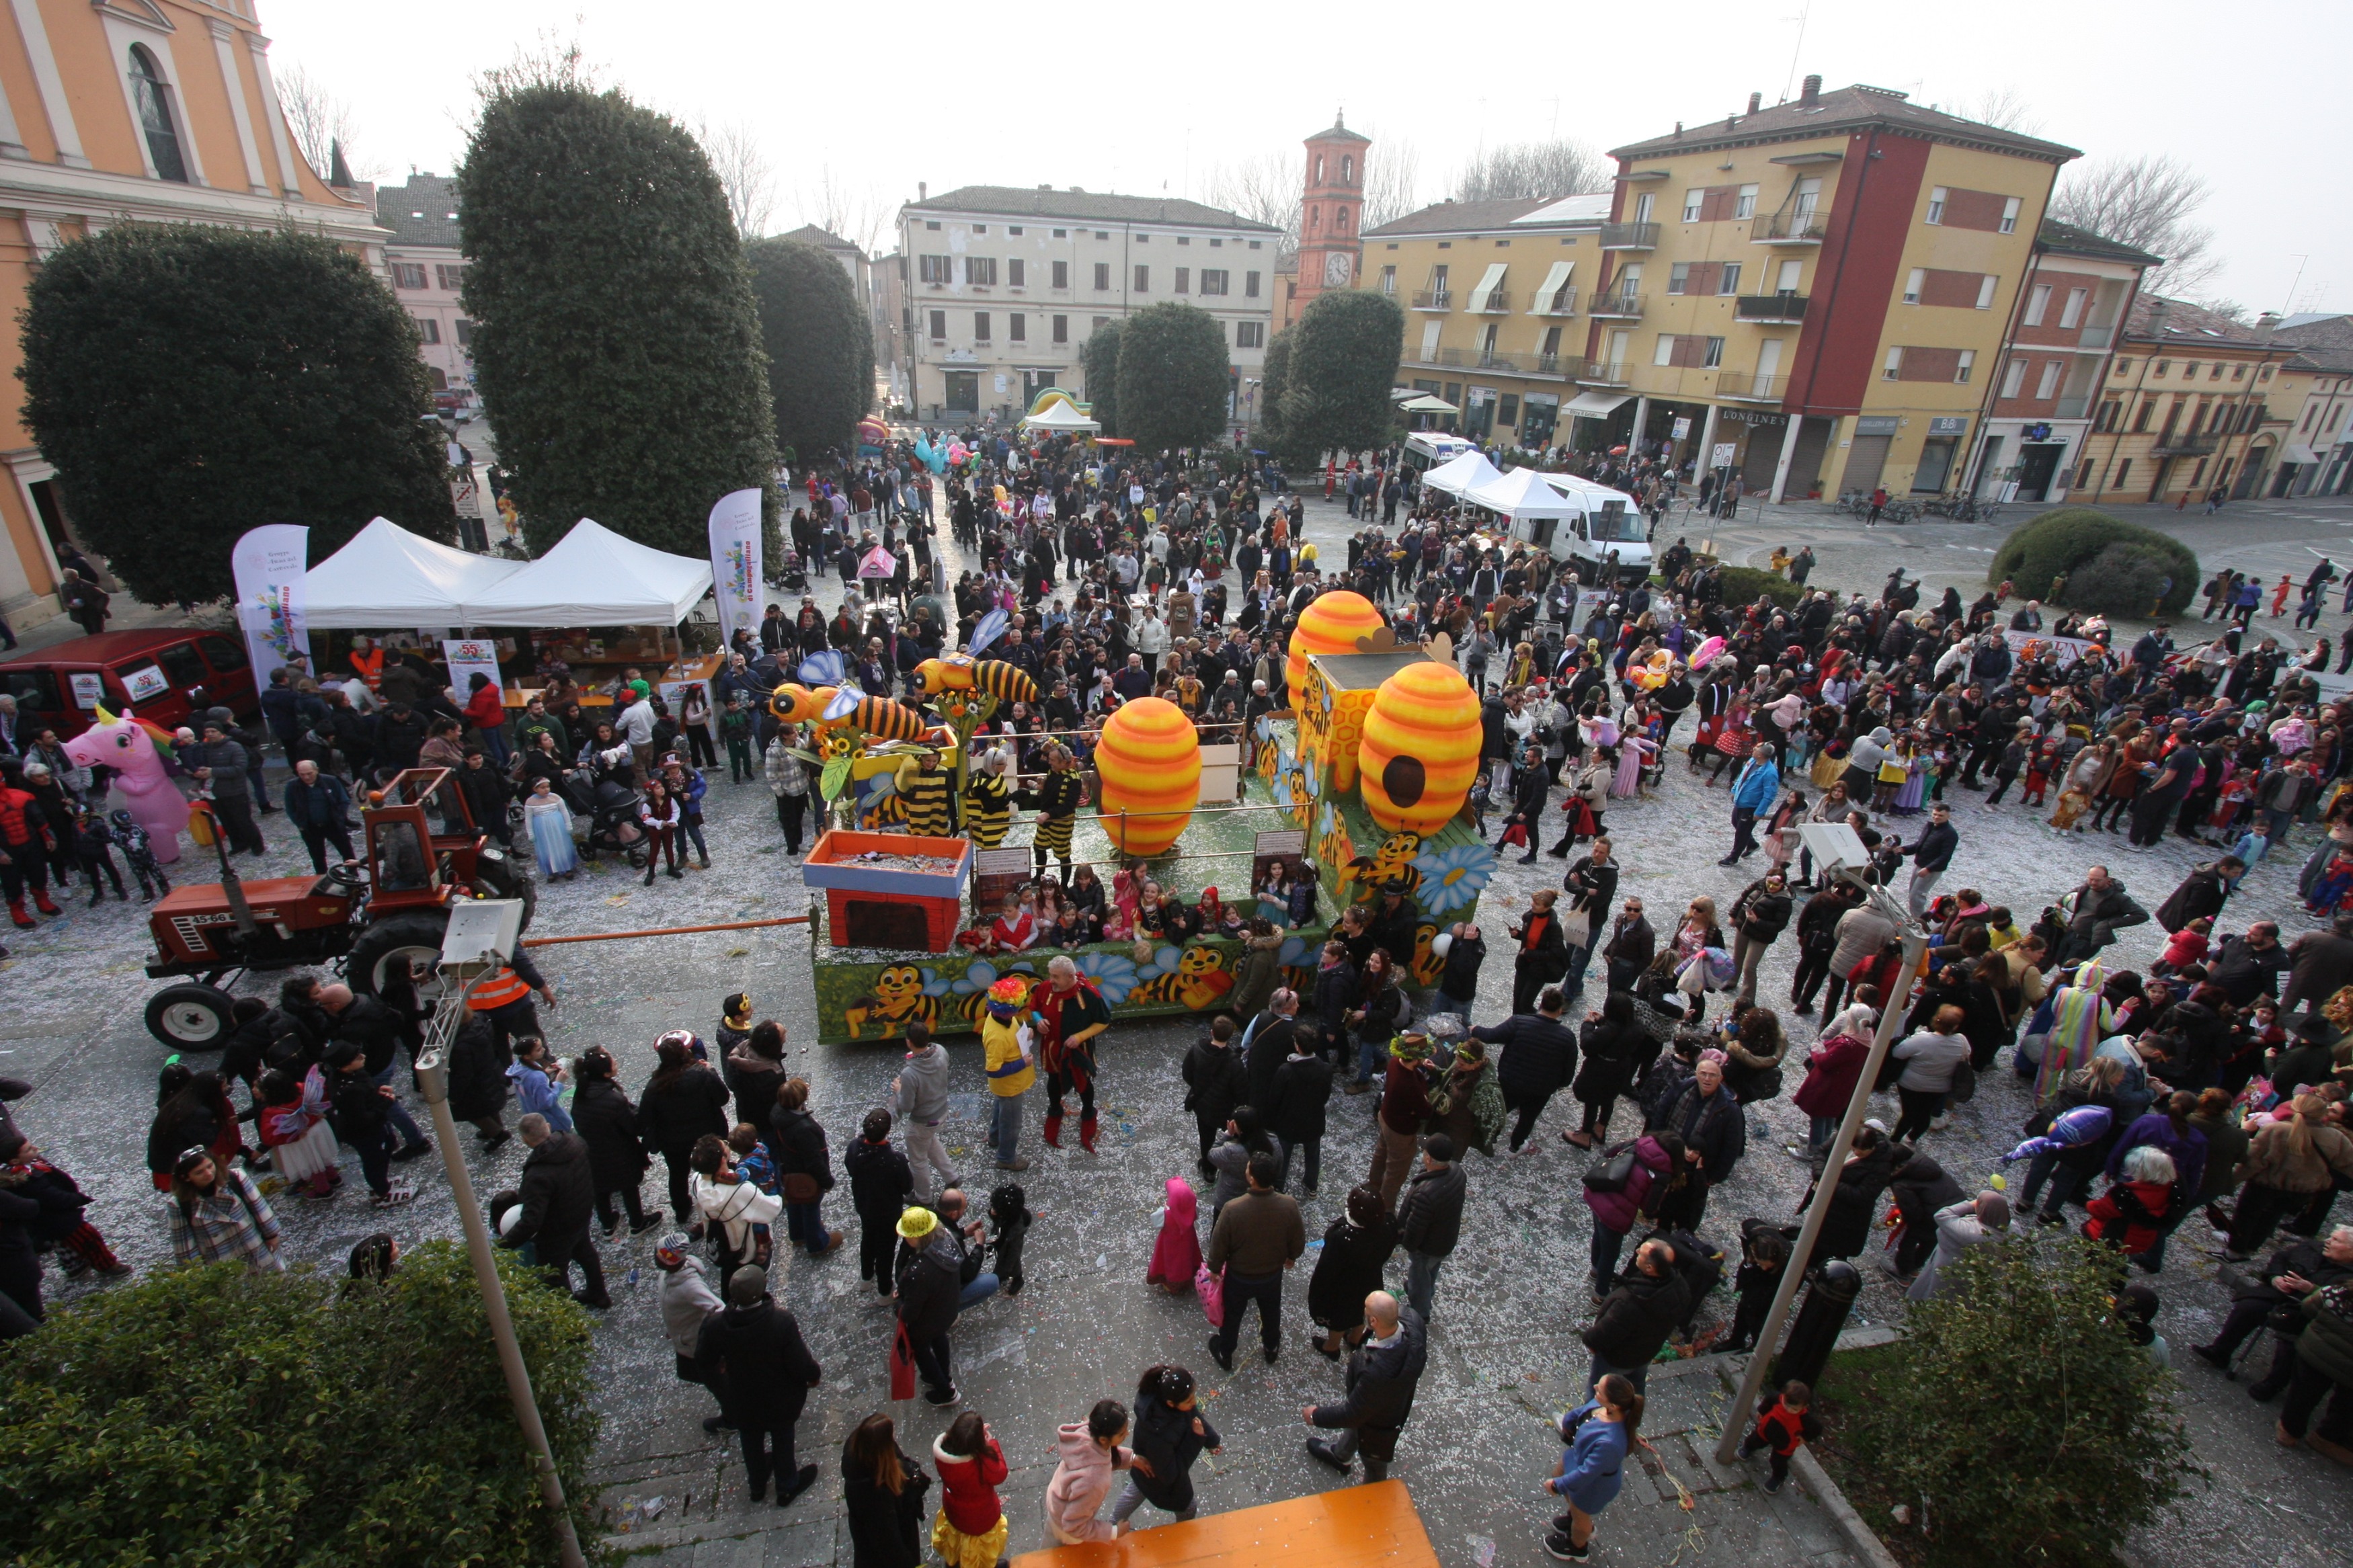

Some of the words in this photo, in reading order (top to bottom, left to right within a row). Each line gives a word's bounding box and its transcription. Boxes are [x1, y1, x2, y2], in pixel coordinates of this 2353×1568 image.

[1723, 411, 1786, 425] LONGINES
[745, 540, 753, 593] Campogalliano
[193, 915, 226, 923] 45-66
